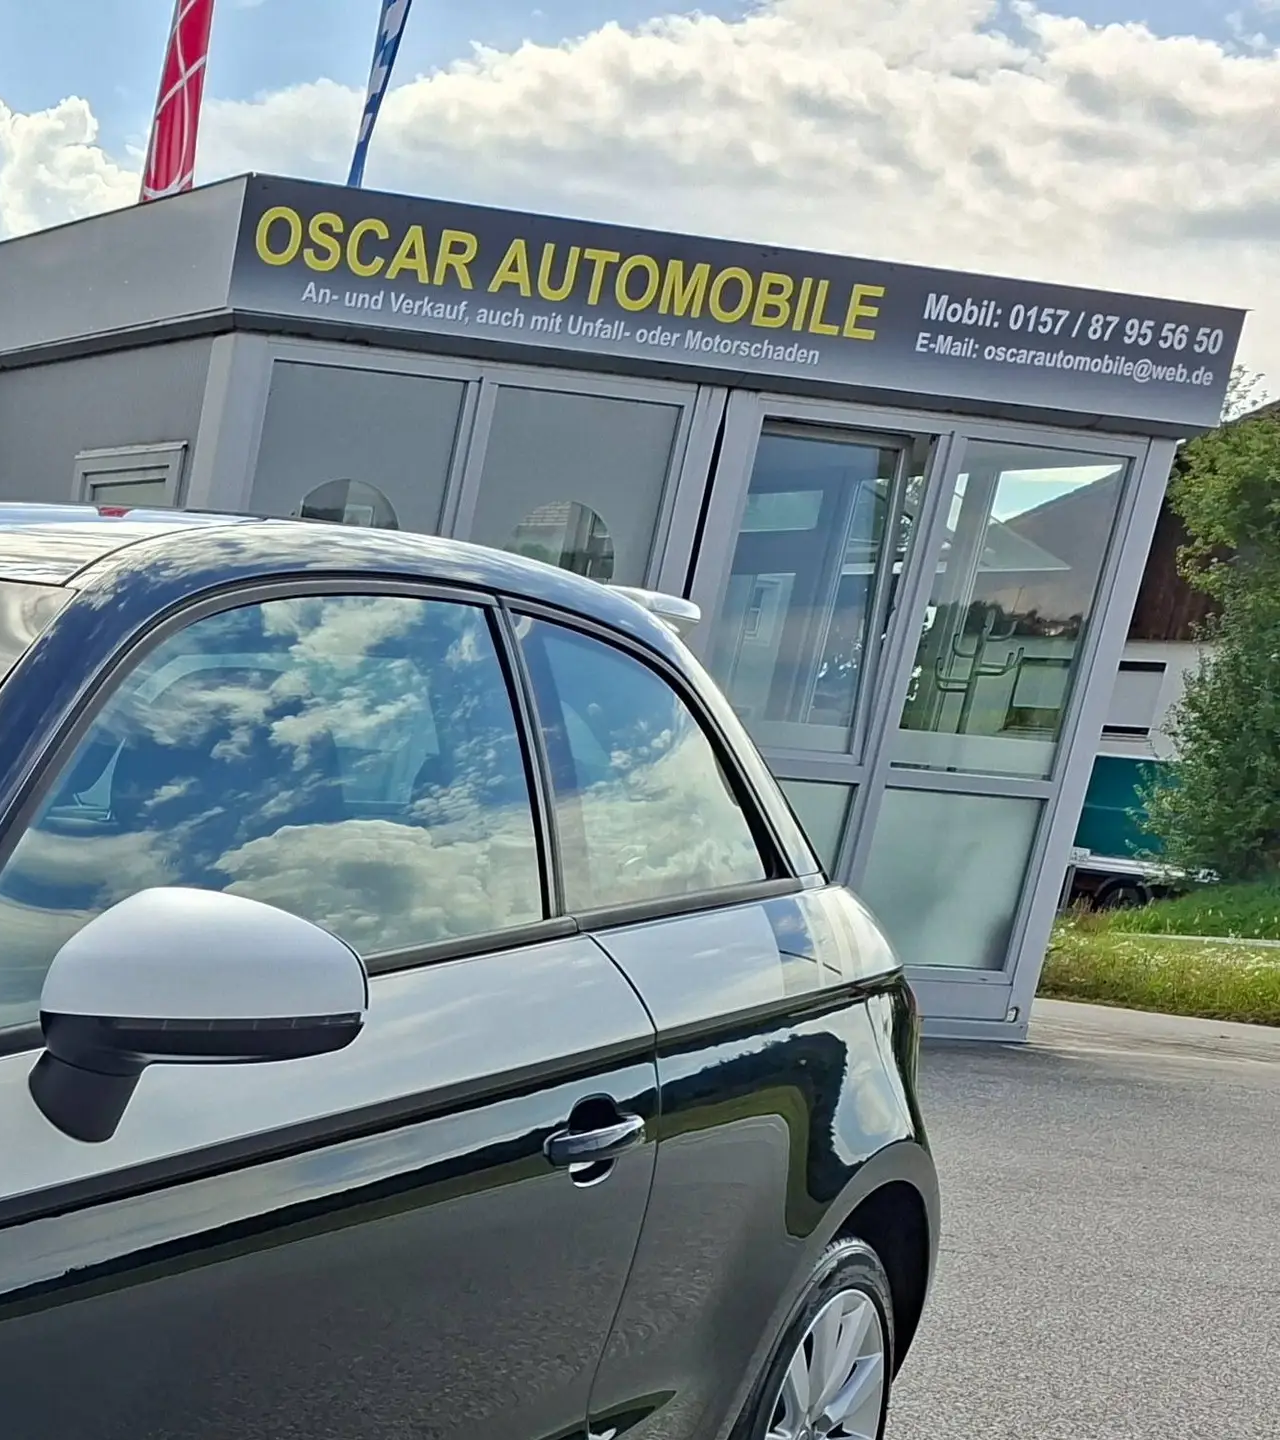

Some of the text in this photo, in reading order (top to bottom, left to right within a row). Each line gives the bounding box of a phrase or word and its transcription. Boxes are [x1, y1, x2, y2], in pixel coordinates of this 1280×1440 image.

[255, 206, 886, 341] OSCAR AUTOMOBILE
[301, 281, 821, 366] An- und Verkauf, auch mit Unfall- oder Motorschaden
[915, 331, 1214, 387] E-Mail: oscarautomobile@web.de
[923, 293, 1224, 355] Mobil: 0157 / 87 95 56 50
